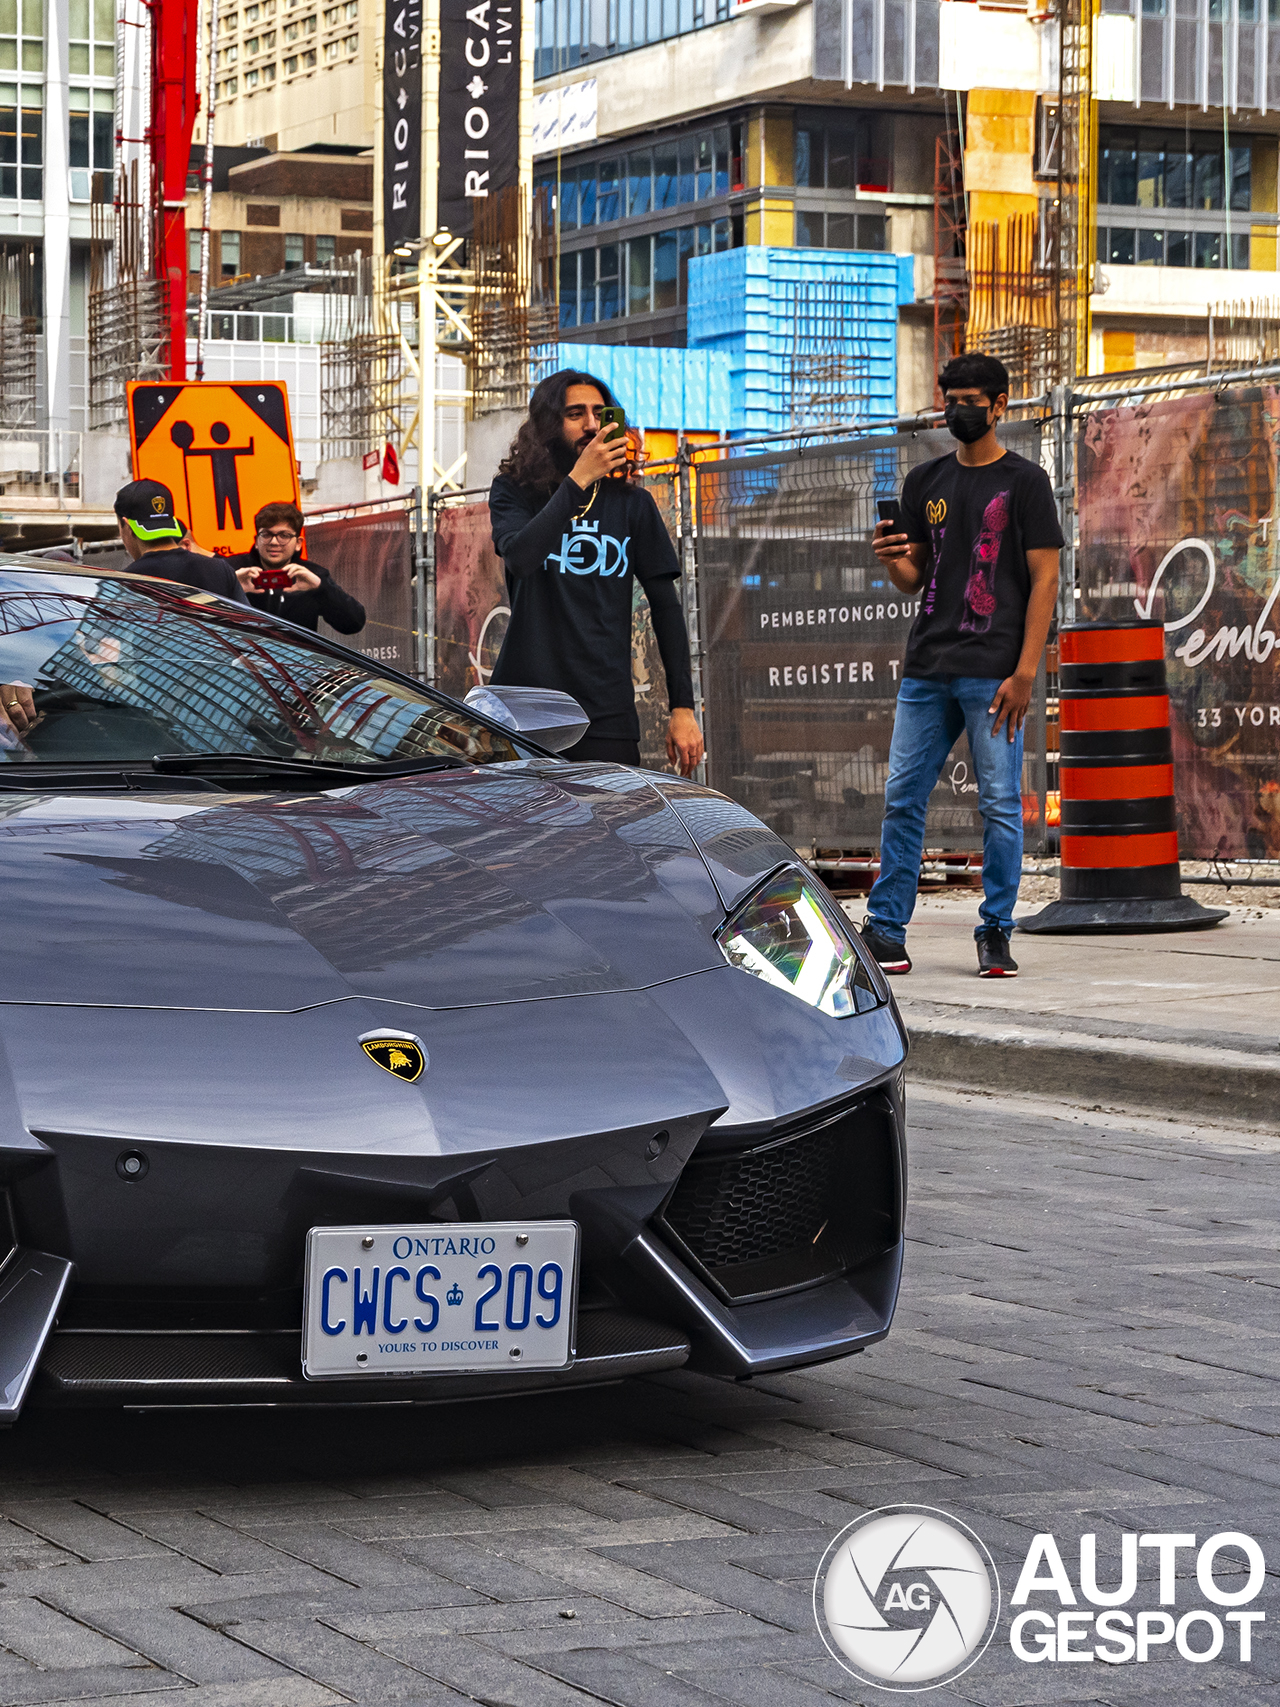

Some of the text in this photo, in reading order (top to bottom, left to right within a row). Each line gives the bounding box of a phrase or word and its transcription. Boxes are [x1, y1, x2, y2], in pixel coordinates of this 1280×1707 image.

[496, 7, 512, 64] LIVI
[392, 117, 409, 211] RIO
[464, 106, 490, 198] RIO
[1134, 537, 1280, 667] Pemb
[357, 645, 401, 660] DRESS.
[769, 661, 874, 686] REGISTER
[1197, 708, 1221, 728] 33
[366, 1042, 415, 1051] LAMBORGHINI
[321, 1261, 564, 1336] CWCS 209
[378, 1340, 499, 1354] YOURS TO DISCOVER
